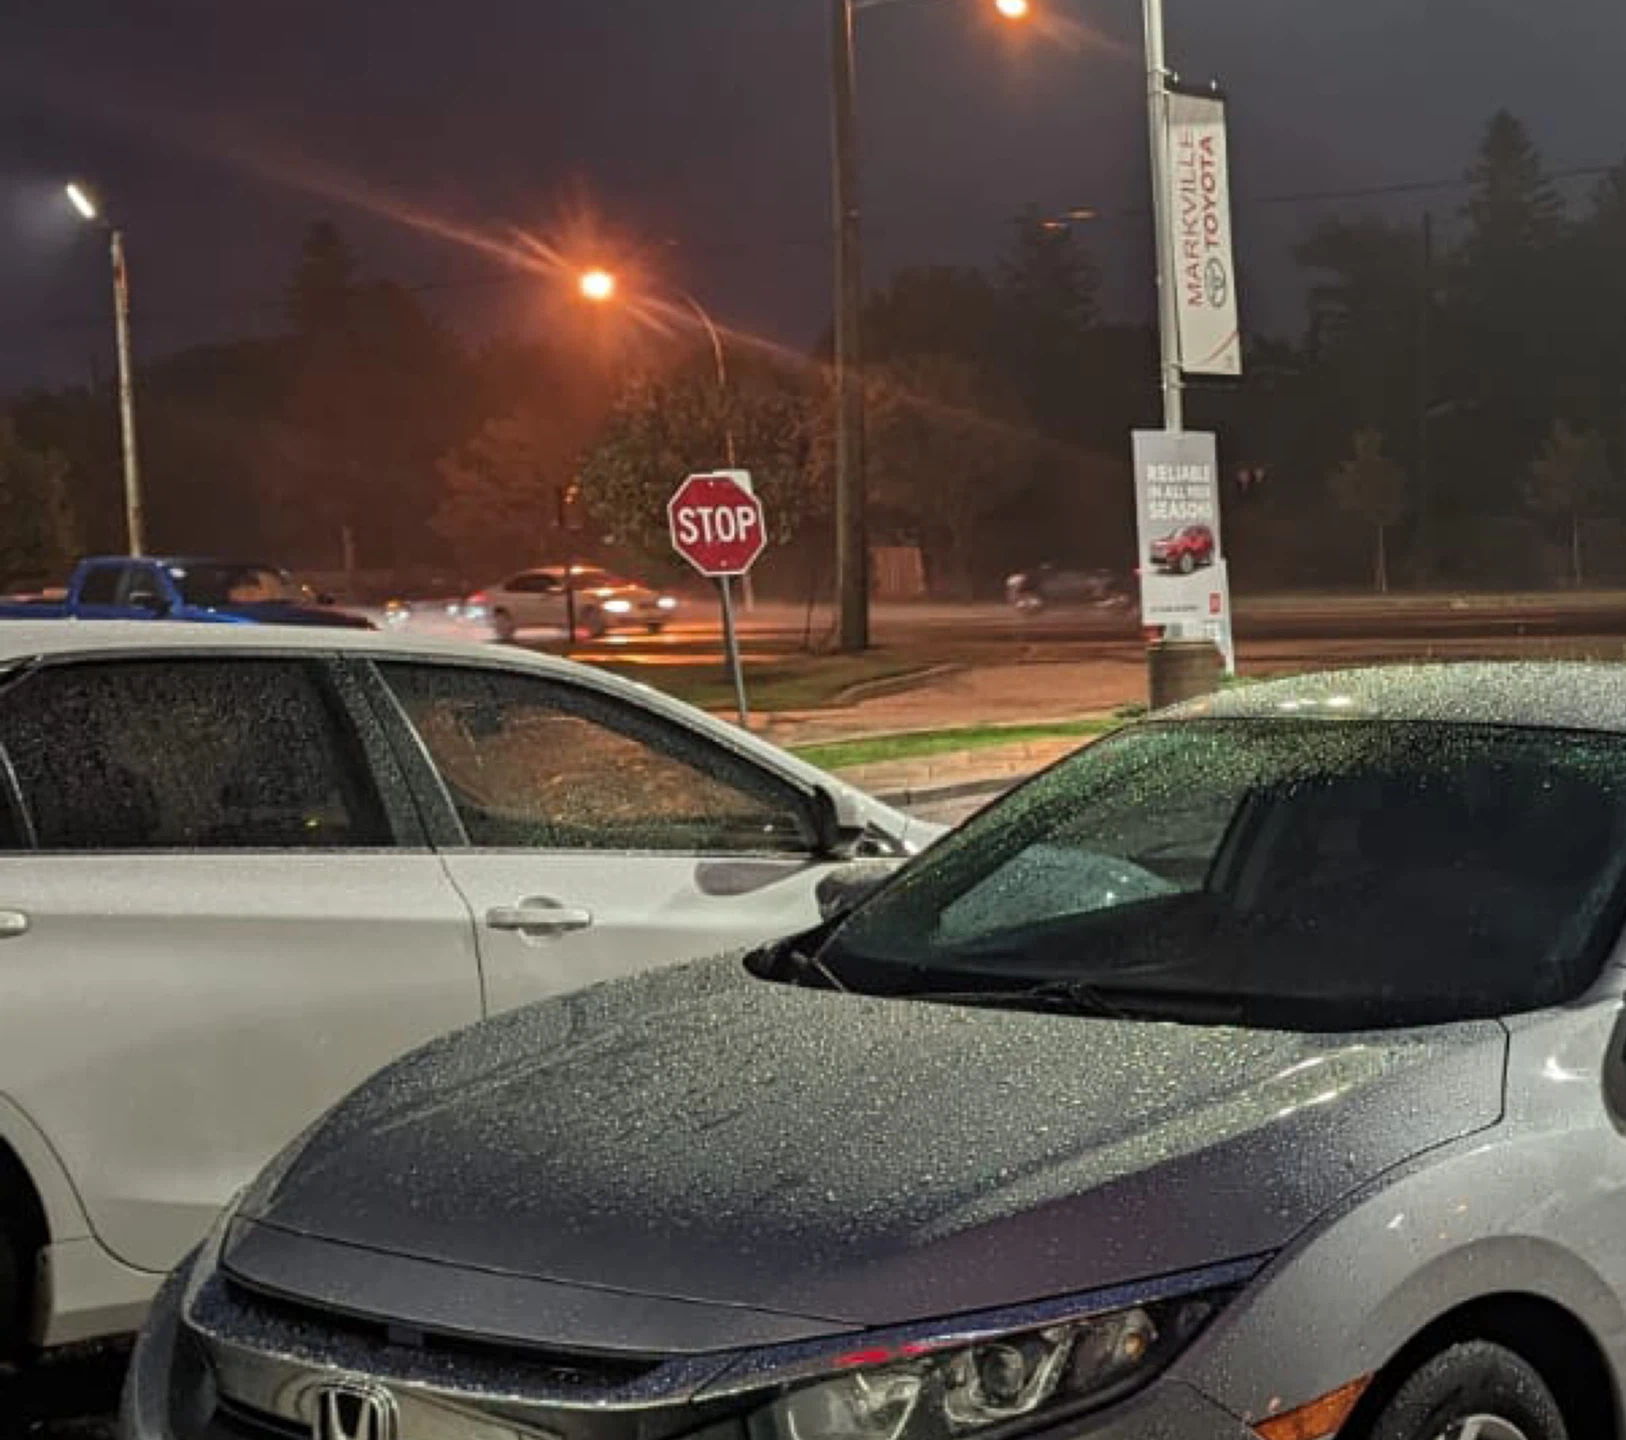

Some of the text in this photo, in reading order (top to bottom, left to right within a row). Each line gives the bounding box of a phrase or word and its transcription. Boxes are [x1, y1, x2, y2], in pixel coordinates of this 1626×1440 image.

[1177, 127, 1203, 306] MARKVILLE
[1199, 136, 1221, 248] TOYOTA
[677, 505, 757, 546] STOP
